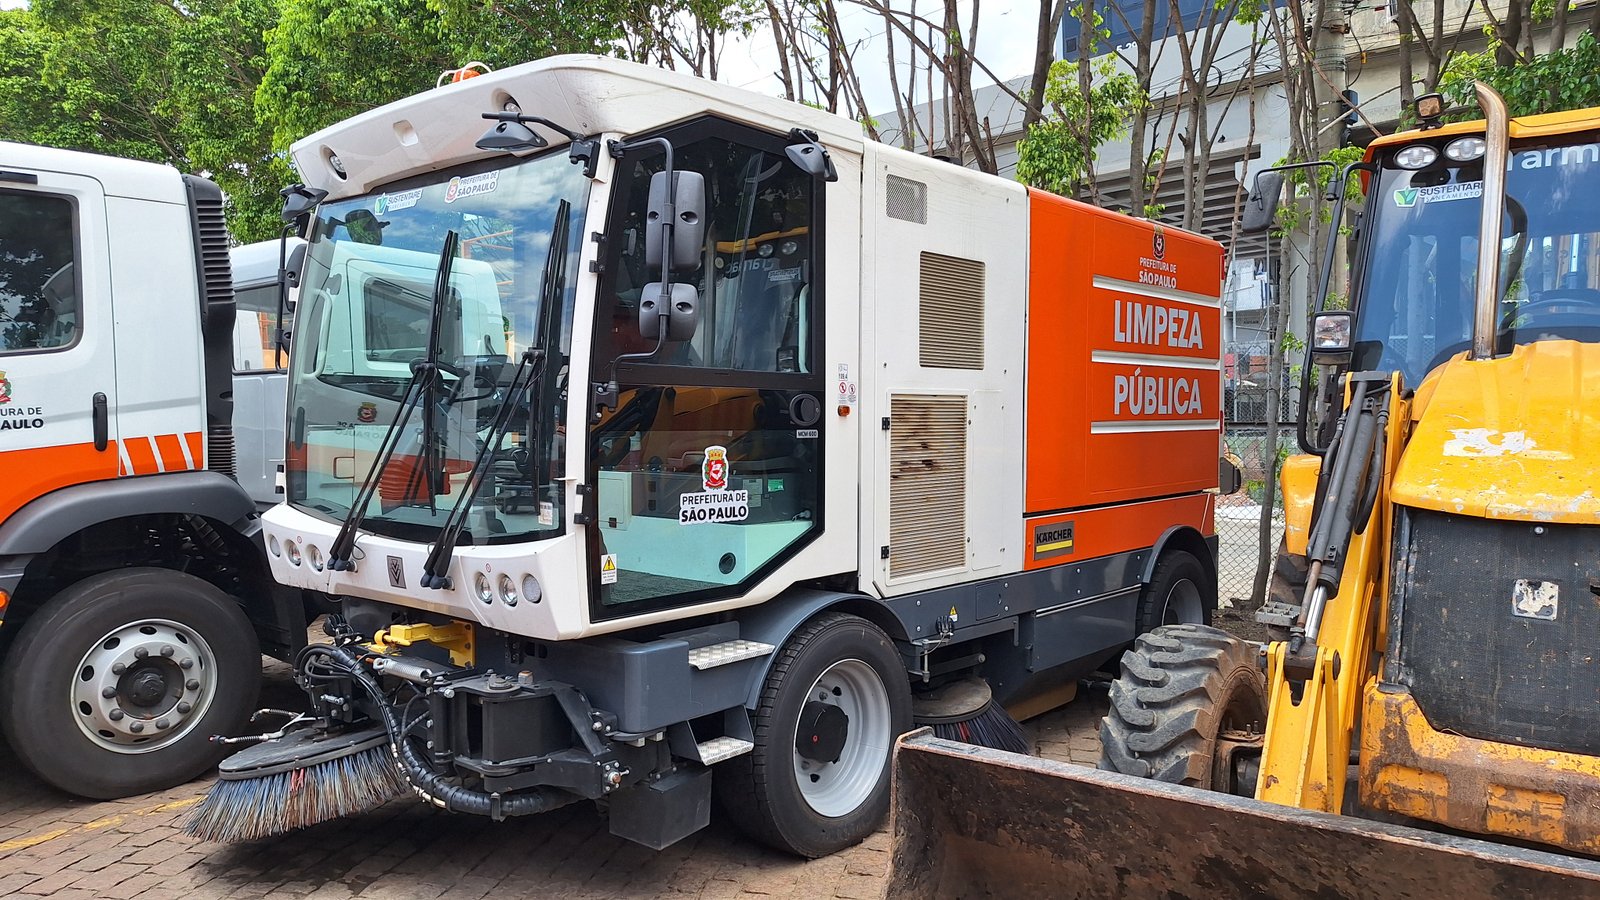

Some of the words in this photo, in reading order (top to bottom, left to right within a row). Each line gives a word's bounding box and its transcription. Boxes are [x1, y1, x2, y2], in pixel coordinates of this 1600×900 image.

[460, 174, 490, 186] PREFEITURA
[490, 171, 498, 179] DE
[457, 185, 473, 197] SÃO
[472, 181, 496, 194] PAULO
[1139, 257, 1169, 272] PREFEITURA
[1169, 264, 1177, 273] DE
[1139, 269, 1154, 284] SÃO
[1153, 273, 1177, 289] PAULO
[1114, 300, 1203, 349] LIMPEZA
[1114, 367, 1203, 416] PÚBLICA
[27, 406, 42, 415] DE
[682, 494, 733, 505] PREFEITURA
[735, 492, 746, 502] DE
[681, 506, 706, 522] SÃO
[708, 505, 747, 520] PAULO
